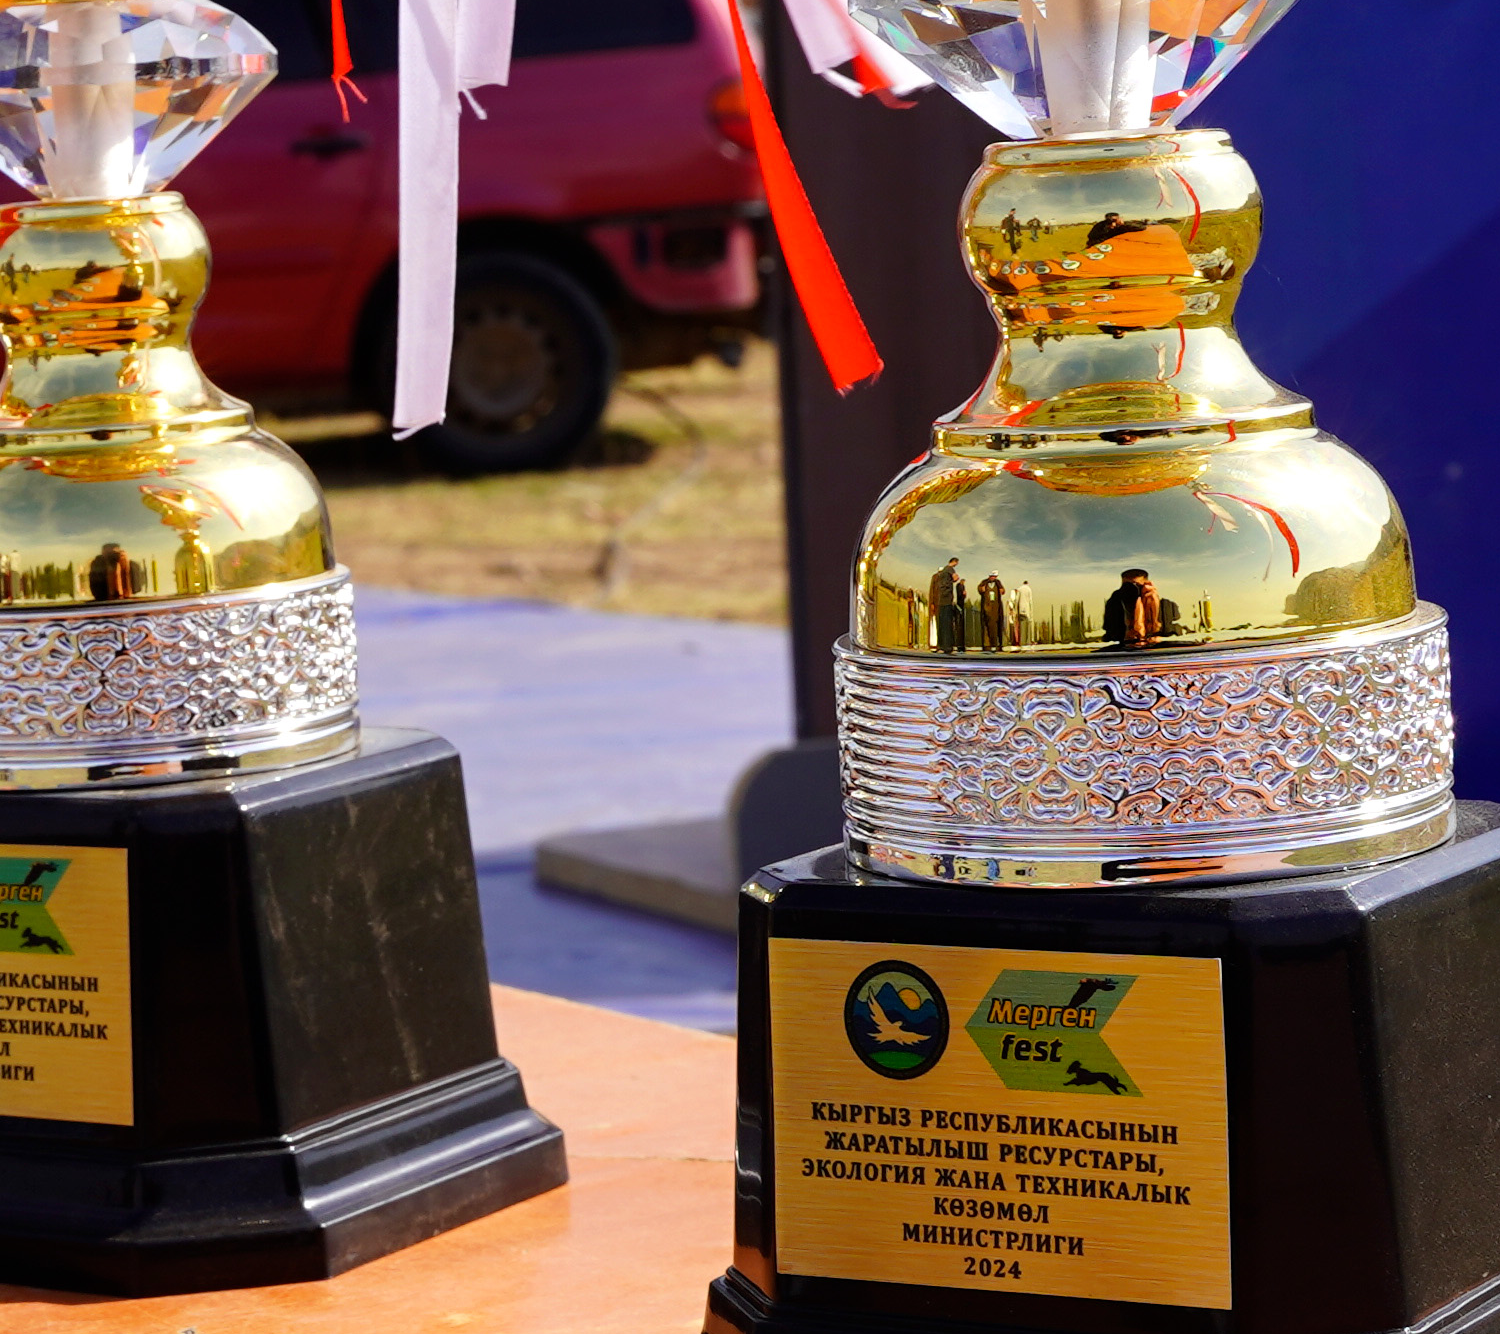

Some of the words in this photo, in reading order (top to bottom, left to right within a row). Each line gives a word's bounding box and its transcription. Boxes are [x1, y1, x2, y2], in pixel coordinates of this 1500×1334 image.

[987, 999, 1097, 1030] Мерген
[1001, 1033, 1063, 1063] fest
[811, 1102, 911, 1128] КЫРГЫЗ
[920, 1110, 1178, 1145] РЕСПУБЛИКАСЫНЫН
[824, 1131, 989, 1161] ЖАРАТЫЛЫШ
[999, 1143, 1165, 1176] РЕСУРСТАРЫ,
[802, 1158, 926, 1185] ЭКОЛОГИЯ
[935, 1168, 1006, 1191] ЖАНА
[1016, 1174, 1191, 1206] ТЕХНИКАЛЫК
[934, 1197, 1050, 1224] КӨЗӨМӨЛ
[902, 1223, 1085, 1256] МИНИСТРЛИГИ
[964, 1257, 1022, 1280] 2024
